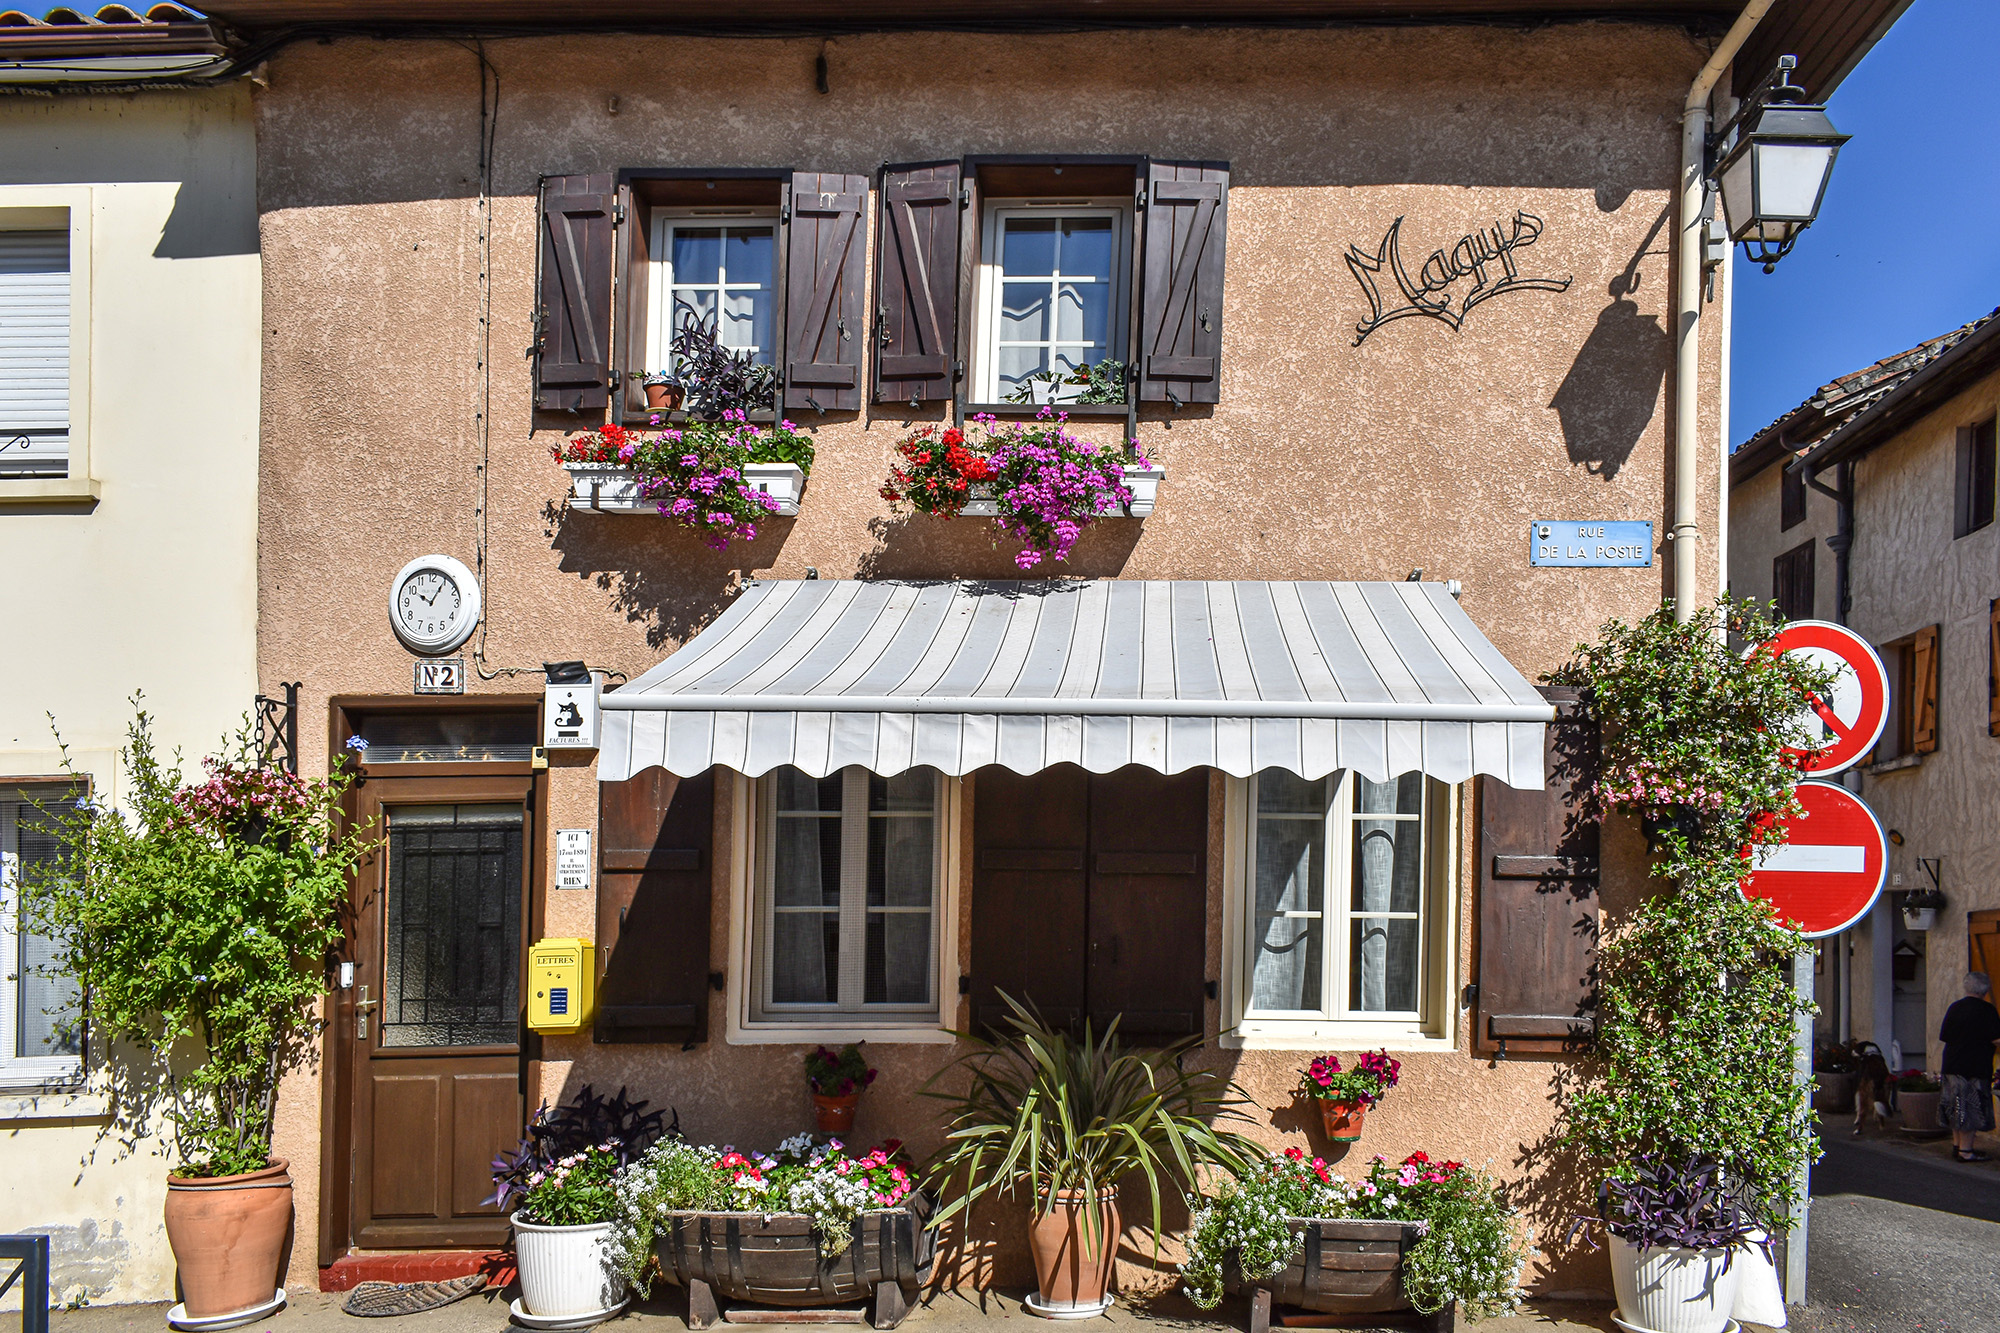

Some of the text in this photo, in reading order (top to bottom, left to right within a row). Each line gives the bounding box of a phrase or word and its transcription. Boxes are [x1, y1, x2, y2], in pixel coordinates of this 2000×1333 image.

[1578, 527, 1605, 538] RUE
[1539, 545, 1643, 559] DE LA POSTE
[417, 576, 424, 586] 11
[429, 573, 437, 583] 12
[408, 585, 417, 595] 10
[451, 586, 457, 596] 2
[404, 597, 410, 607] 9
[454, 599, 460, 608] 3
[407, 610, 413, 620] 8
[449, 611, 454, 621] 4
[418, 620, 423, 630] 7
[428, 623, 433, 633] 6
[440, 620, 445, 630] 5
[441, 666, 454, 686] 2
[564, 877, 581, 885] RIEN
